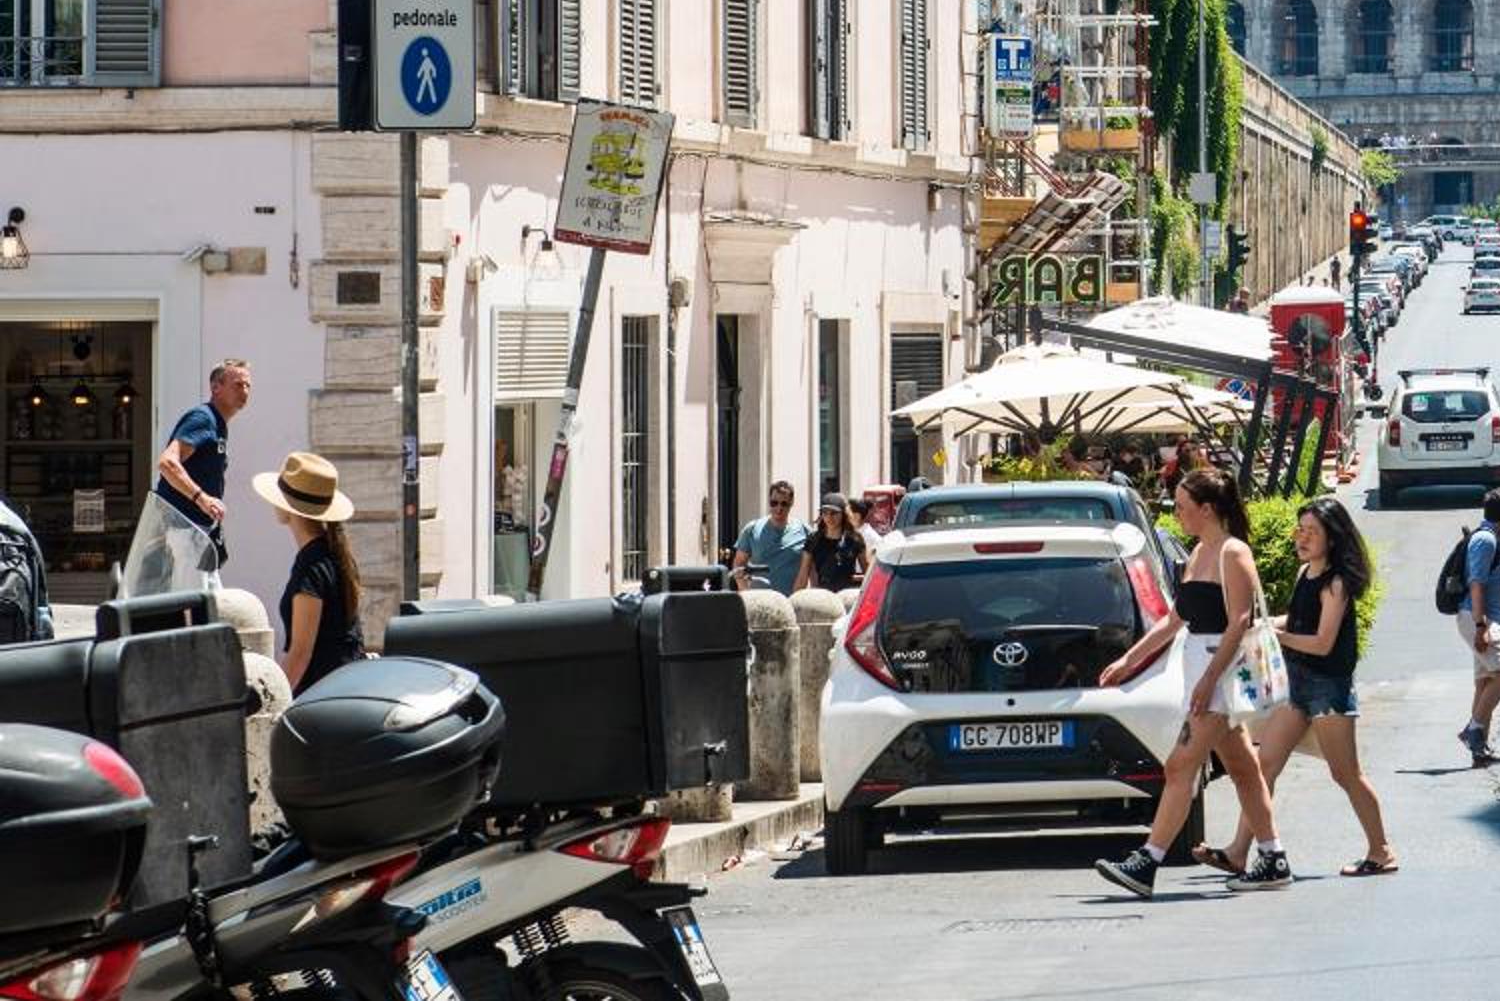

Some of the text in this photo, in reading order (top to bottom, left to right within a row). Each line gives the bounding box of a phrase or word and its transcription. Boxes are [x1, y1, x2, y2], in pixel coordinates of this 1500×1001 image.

[393, 9, 457, 29] pedonale
[1002, 41, 1025, 70] T
[963, 724, 1060, 746] GG 708WP
